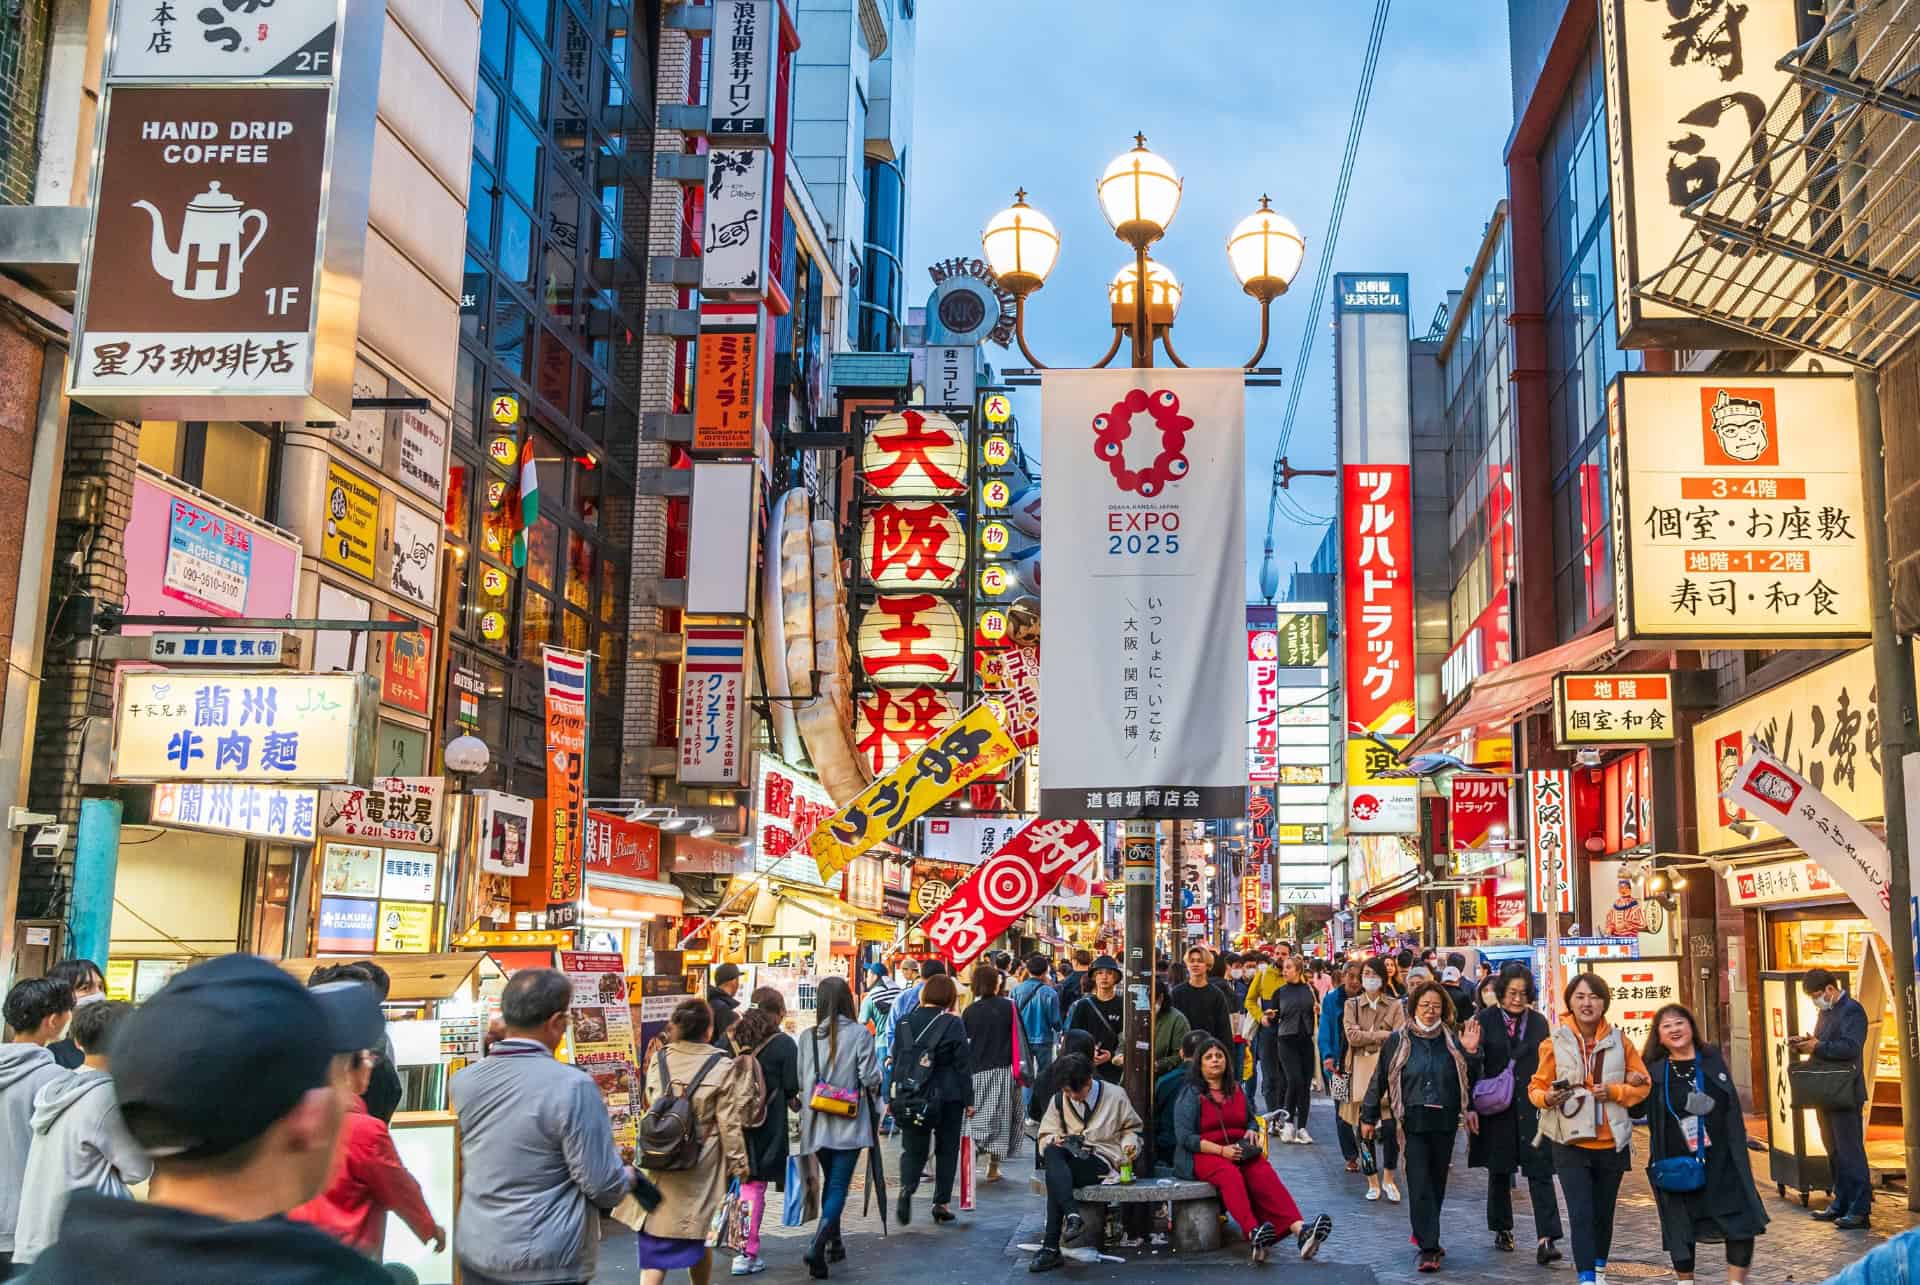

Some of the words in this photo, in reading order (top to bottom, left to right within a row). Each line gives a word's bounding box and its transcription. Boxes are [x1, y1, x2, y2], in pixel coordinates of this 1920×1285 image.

[146, 0, 176, 54] 本店
[295, 52, 329, 71] 2F
[729, 2, 756, 117] 浪花囲碁サロン
[142, 121, 218, 140] HAND
[229, 121, 294, 140] DRIP
[163, 145, 269, 164] COFFEE
[264, 287, 300, 316] 1F
[92, 338, 299, 381] 星乃珈琲店
[716, 336, 737, 429] ミティラー
[175, 502, 249, 553] テナント募集
[1108, 512, 1180, 532] EXPO
[1644, 504, 1857, 542] 個室・お座敷
[1108, 534, 1180, 555] 2025
[1690, 552, 1806, 571] 地階・1・2階
[857, 410, 969, 777] 大阪王将
[1358, 471, 1400, 701] ツルハドラッグ
[1670, 577, 1842, 618] 寿司・和食
[1594, 678, 1637, 699] 地階
[194, 684, 279, 728] 蘭州
[705, 673, 722, 754] クンテープ
[1569, 707, 1667, 732] 個室・和食
[1087, 789, 1201, 809] 道頓堀商店会
[1455, 781, 1507, 798] ツルハ
[365, 790, 433, 826] 電球屋
[1455, 801, 1497, 813] ドラッグ
[360, 826, 416, 841] 6211-5373
